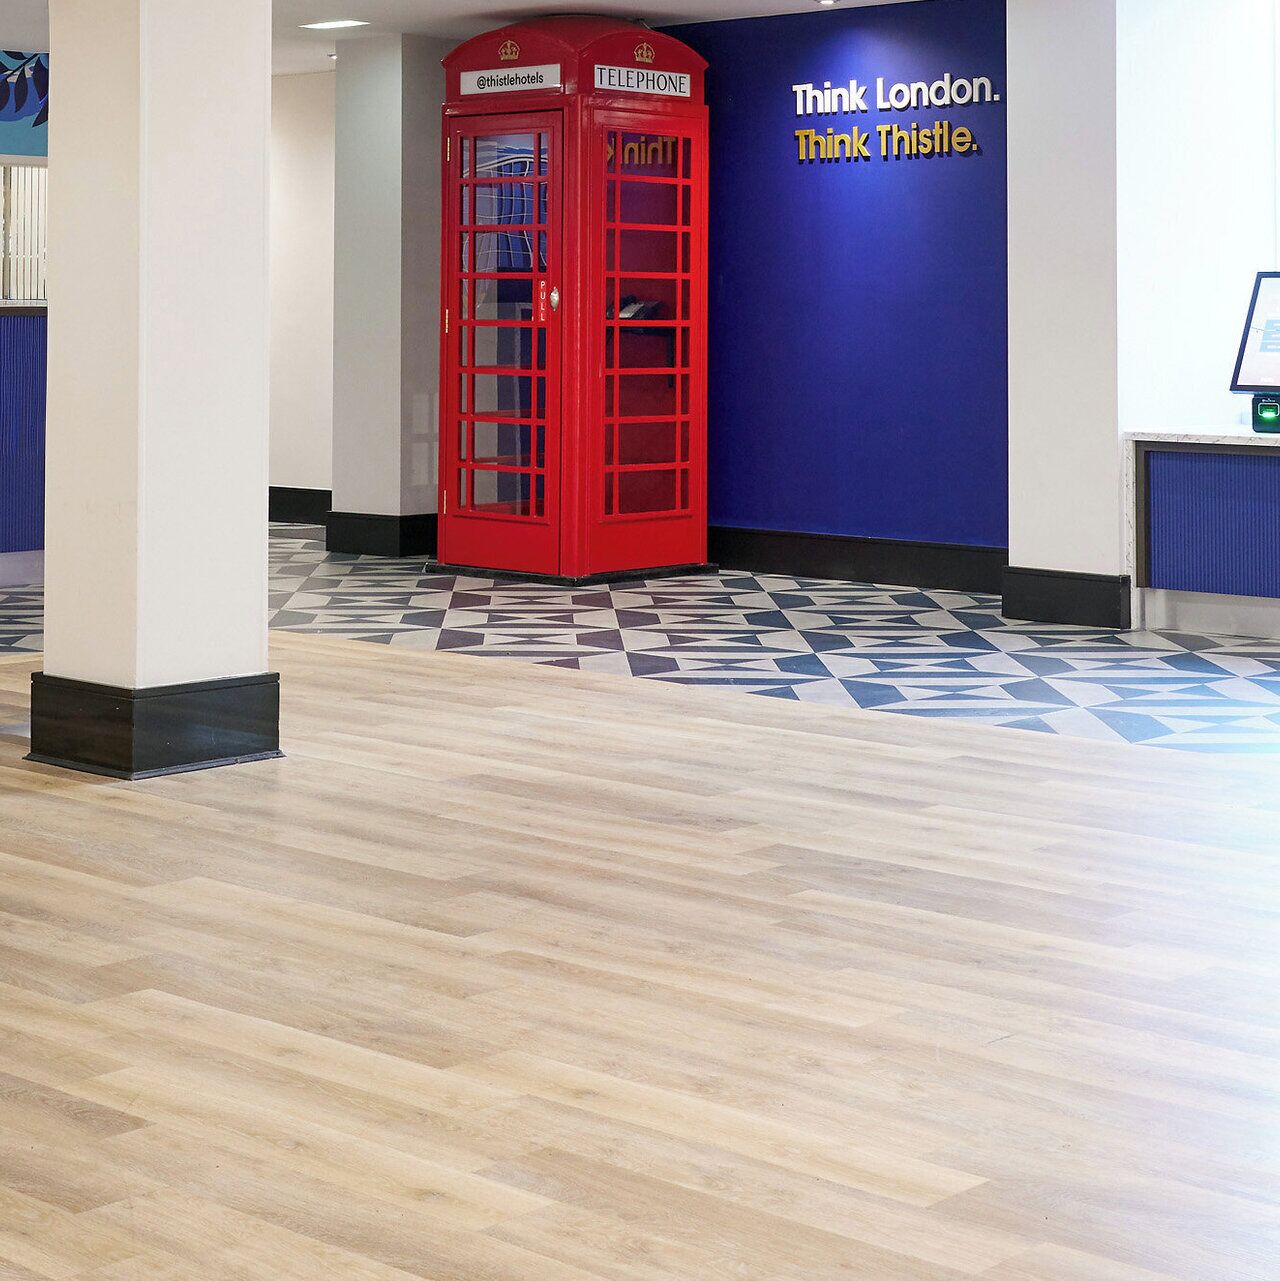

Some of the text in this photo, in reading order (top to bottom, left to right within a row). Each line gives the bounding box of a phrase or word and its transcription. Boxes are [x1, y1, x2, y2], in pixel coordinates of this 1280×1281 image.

[476, 71, 544, 90] @thistlehotels
[597, 67, 688, 94] TELEPHONE
[792, 72, 1000, 116] Think London.
[795, 120, 978, 161] Think Thistle.
